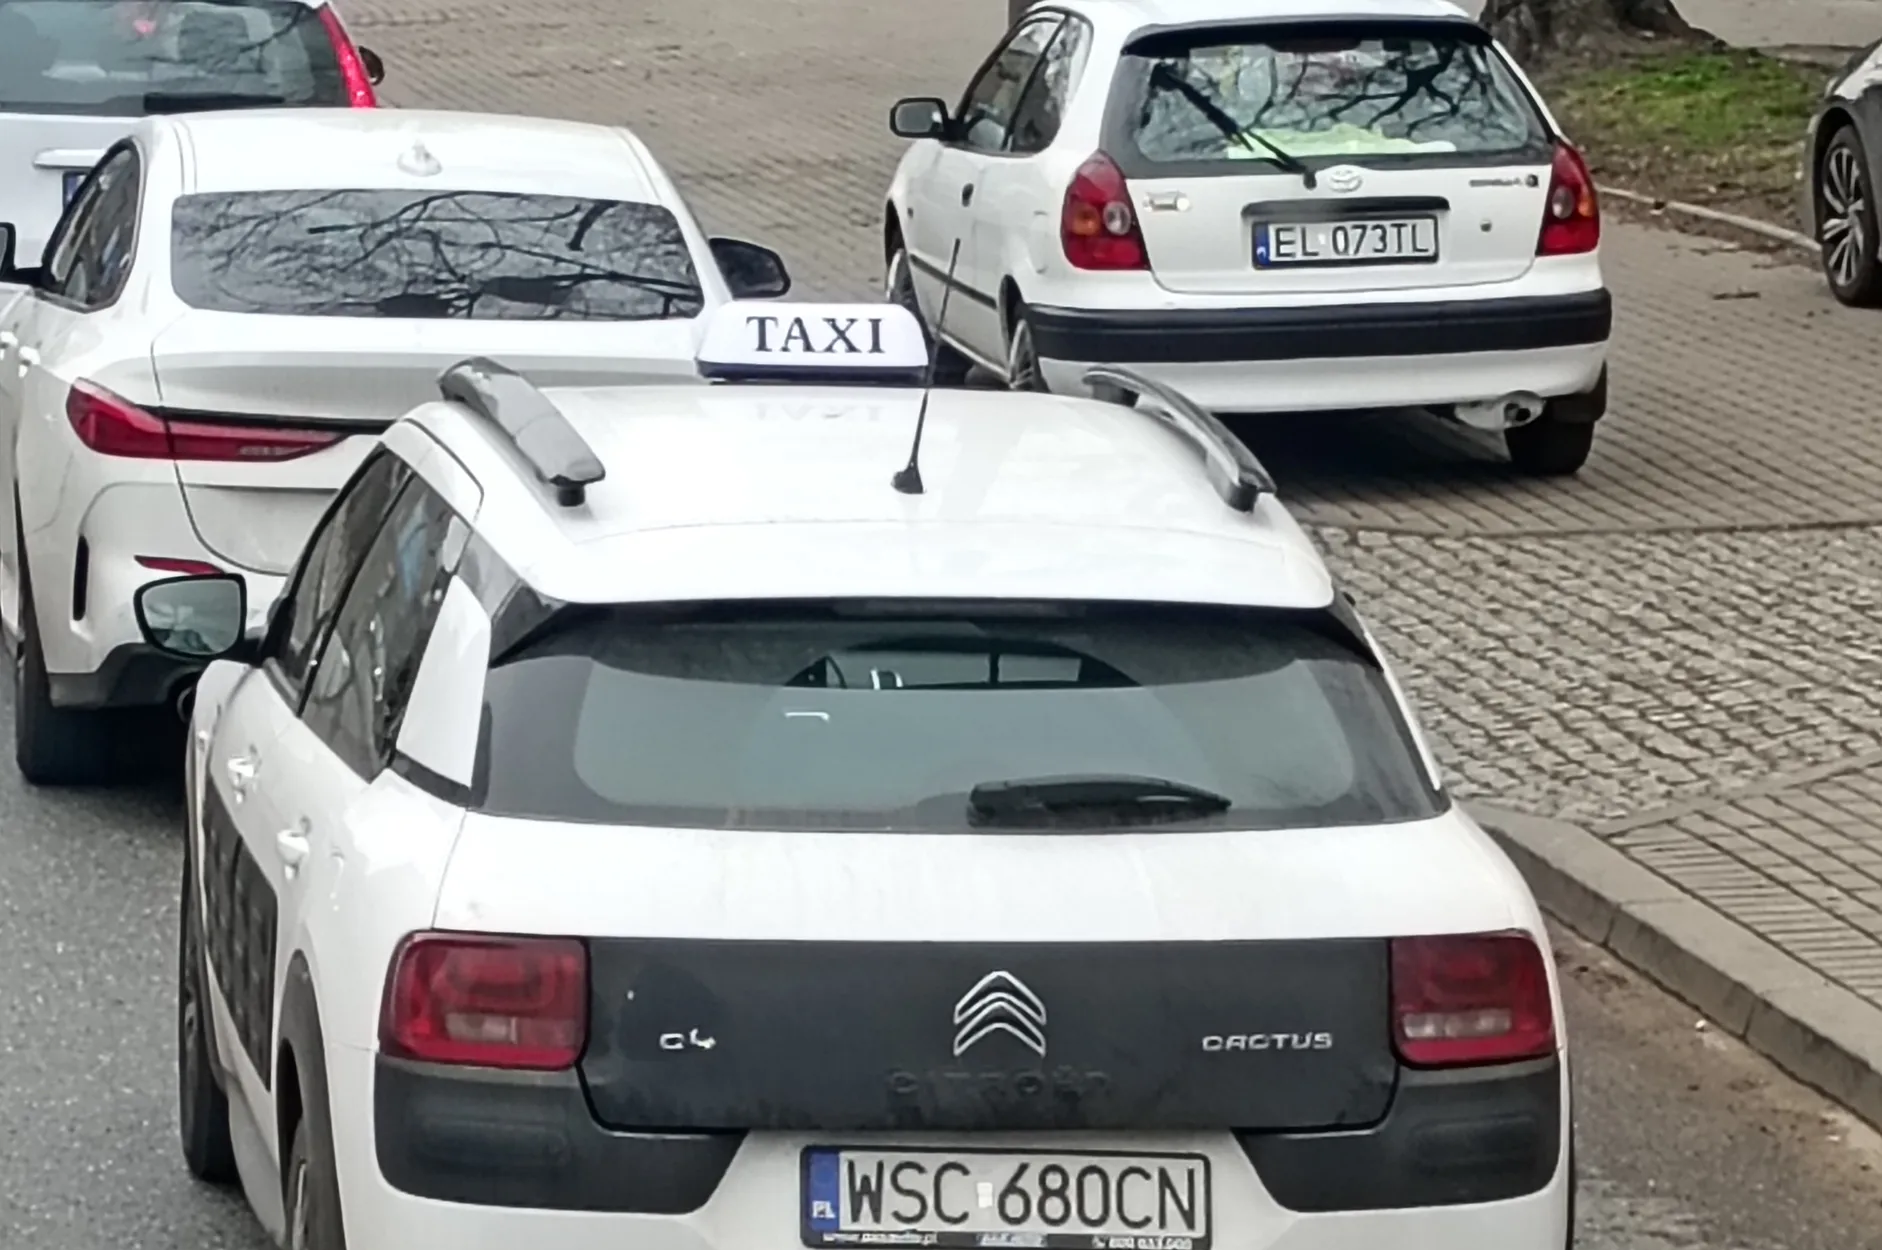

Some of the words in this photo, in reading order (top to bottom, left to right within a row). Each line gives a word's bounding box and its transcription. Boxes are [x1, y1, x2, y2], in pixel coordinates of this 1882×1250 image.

[1275, 226, 1320, 258] EL
[1332, 223, 1430, 257] 073TL
[746, 316, 886, 354] TAXI
[659, 1027, 717, 1050] C4
[1201, 1031, 1333, 1052] CACTUS
[846, 1159, 971, 1225] WSC
[996, 1162, 1196, 1231] 680CN
